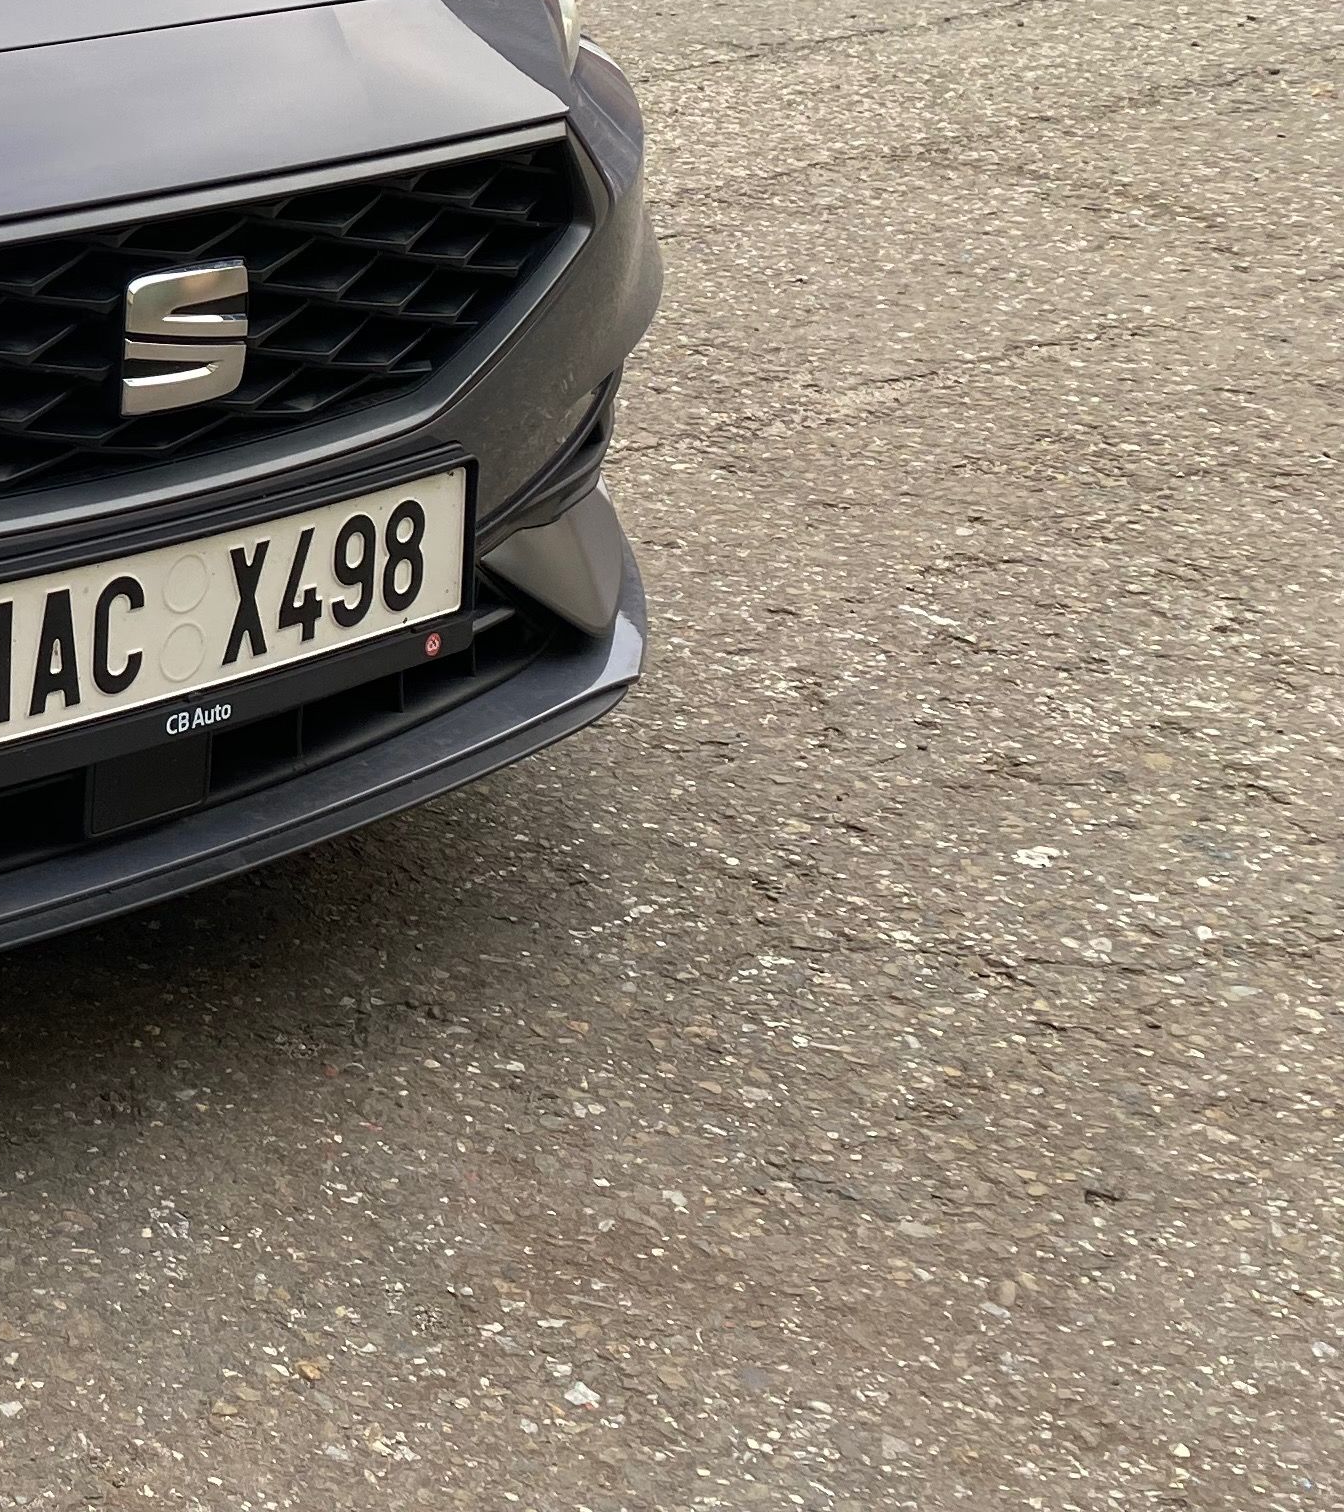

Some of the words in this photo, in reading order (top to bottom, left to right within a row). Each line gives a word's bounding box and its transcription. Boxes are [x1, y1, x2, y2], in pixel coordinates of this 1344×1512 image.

[221, 498, 427, 666] X498
[166, 711, 190, 735] CB
[192, 704, 232, 729] Auto
